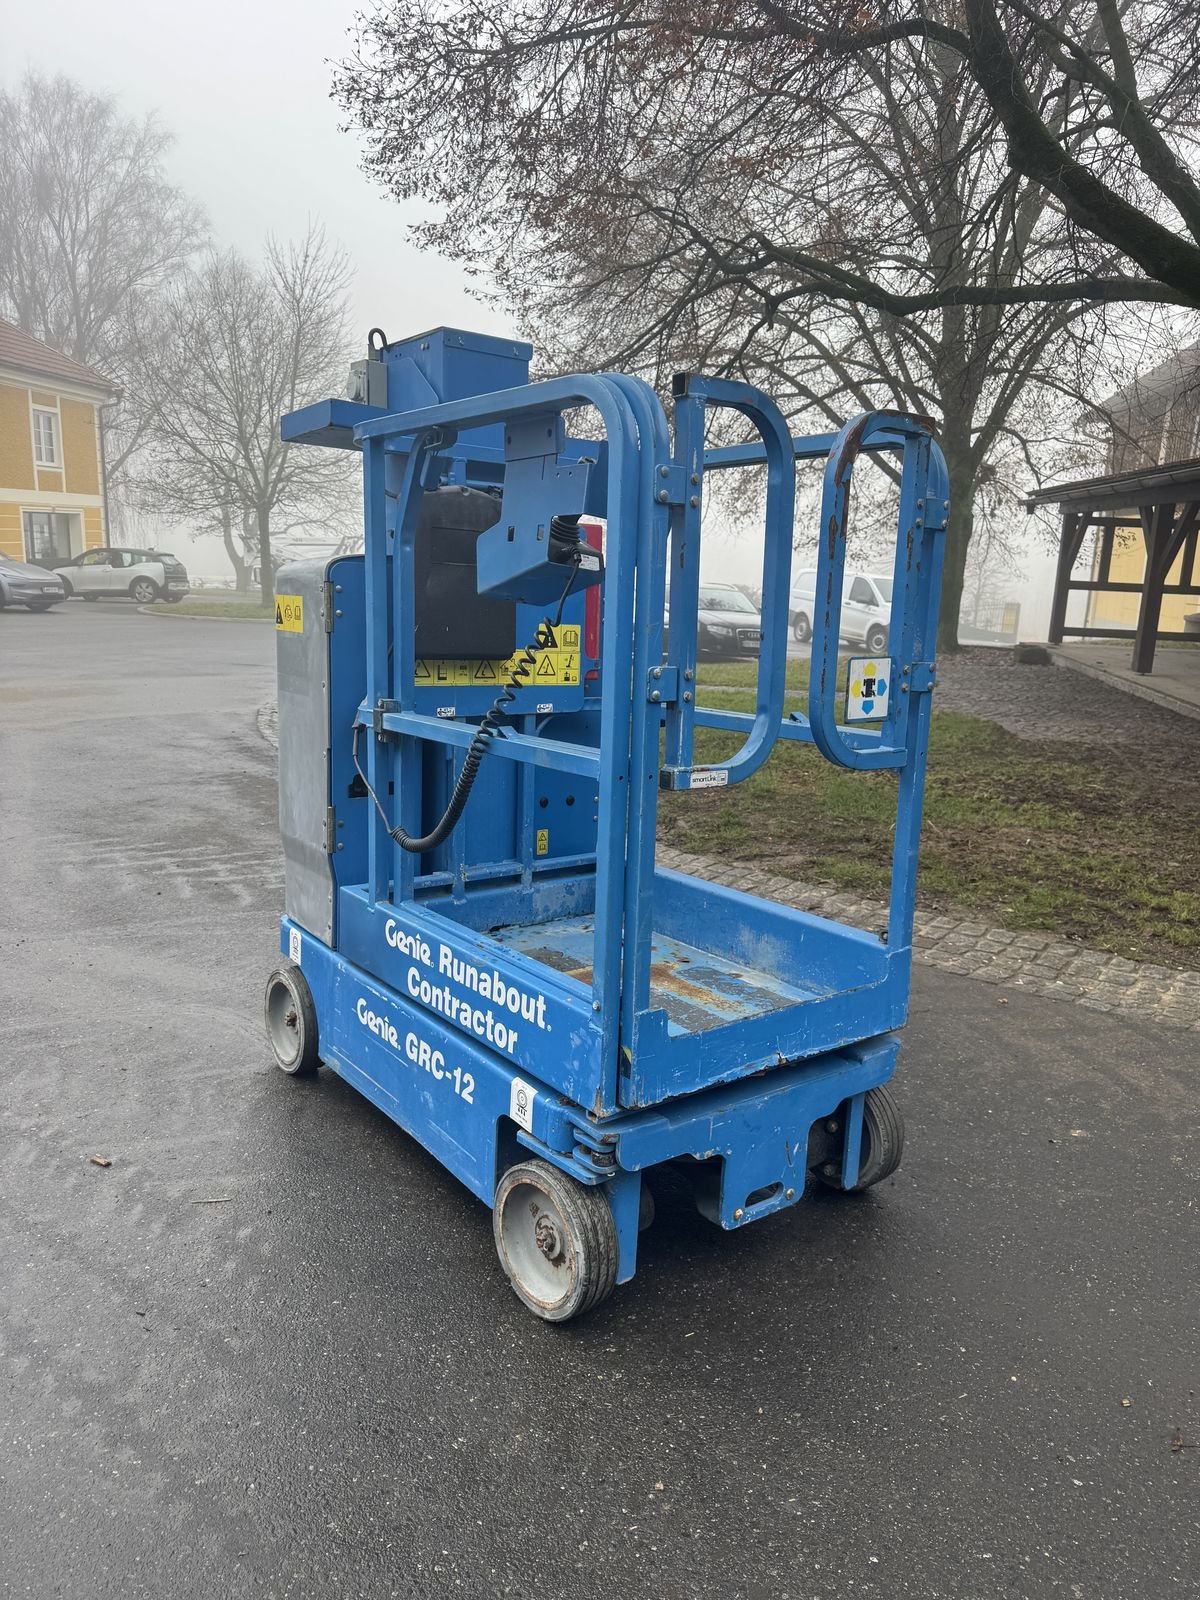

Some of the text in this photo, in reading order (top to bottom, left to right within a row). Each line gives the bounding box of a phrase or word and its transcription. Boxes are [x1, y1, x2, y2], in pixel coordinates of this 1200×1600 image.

[385, 918, 432, 966] Genie
[356, 998, 475, 1105] Genie GRC-12
[407, 966, 518, 1054] Contractor
